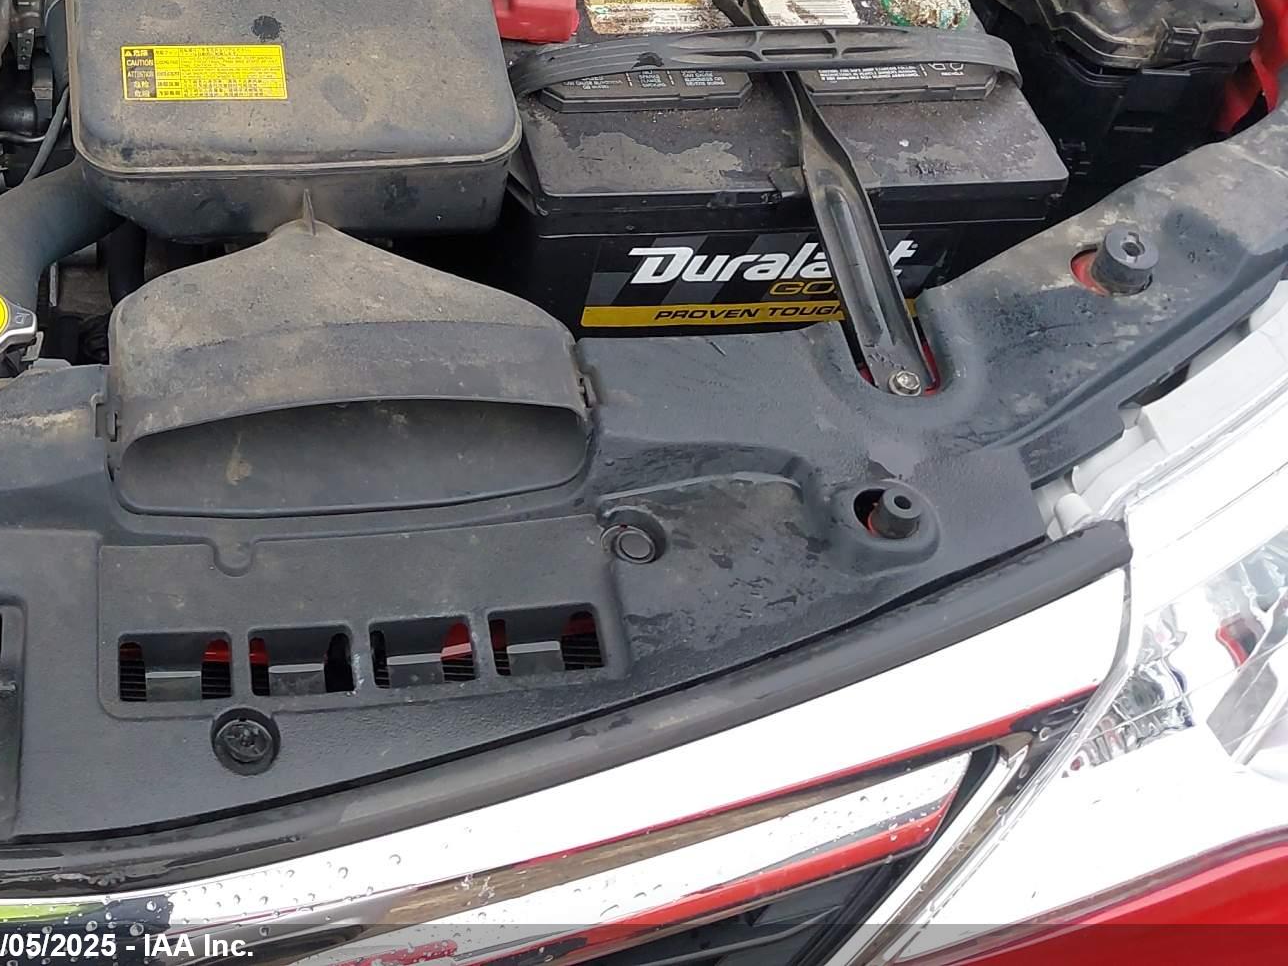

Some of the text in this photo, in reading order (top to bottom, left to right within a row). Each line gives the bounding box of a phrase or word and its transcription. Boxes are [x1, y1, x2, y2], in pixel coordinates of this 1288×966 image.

[126, 59, 154, 67] CAUTION
[127, 71, 155, 79] ATTENTION
[628, 240, 918, 284] Duralat
[654, 308, 760, 321] PROVEN
